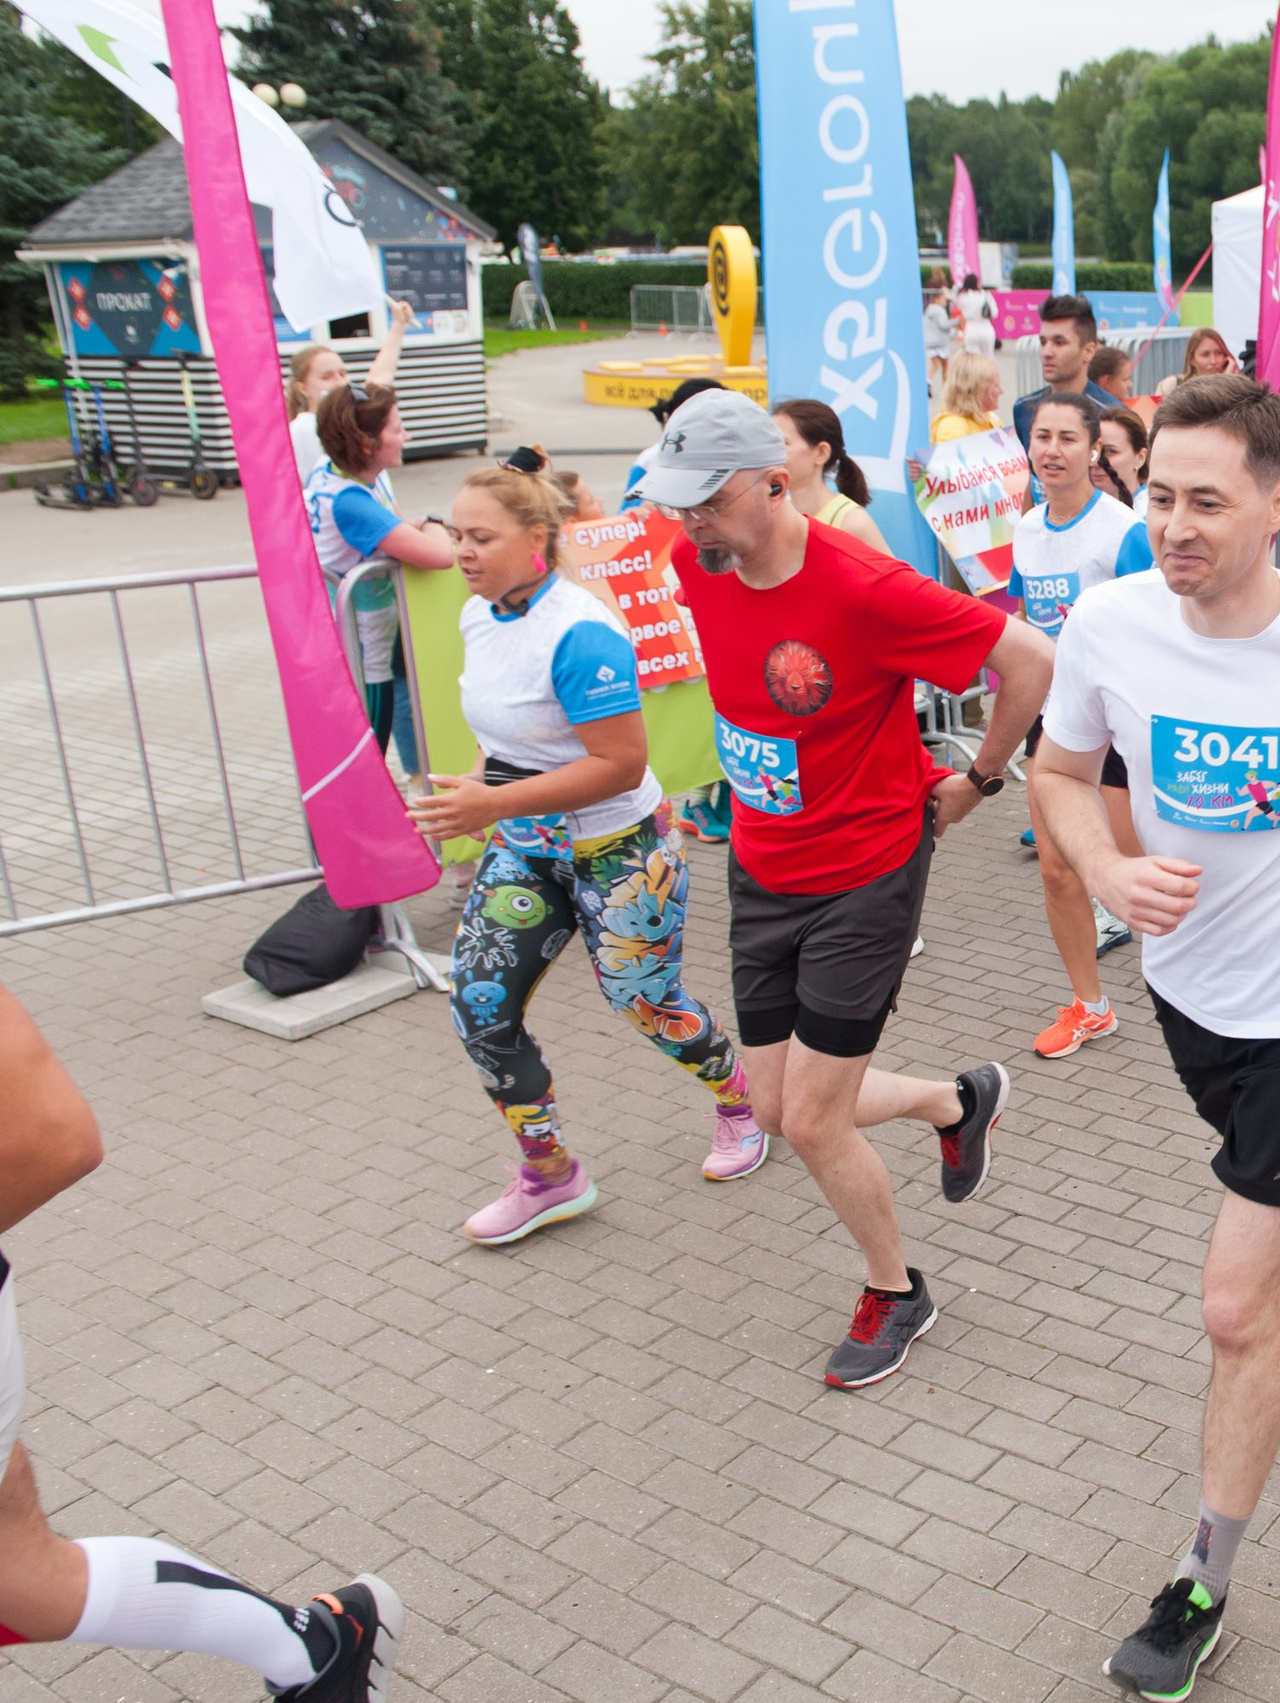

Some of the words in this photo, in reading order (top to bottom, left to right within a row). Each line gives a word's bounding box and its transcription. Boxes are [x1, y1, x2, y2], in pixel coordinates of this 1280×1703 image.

[96, 293, 152, 312] ПРОКАТ
[925, 463, 999, 499] Улыбайся
[999, 455, 1028, 478] всем
[932, 516, 941, 532] с
[943, 504, 990, 530] нами
[575, 521, 647, 548] супер!
[580, 550, 653, 581] класс!
[1026, 578, 1070, 599] 3288
[720, 722, 781, 768] 3075
[1174, 727, 1279, 770] 3041
[1176, 770, 1208, 783] ЗАБЕГ
[1187, 795, 1205, 809] 10
[1211, 794, 1234, 809] КМ
